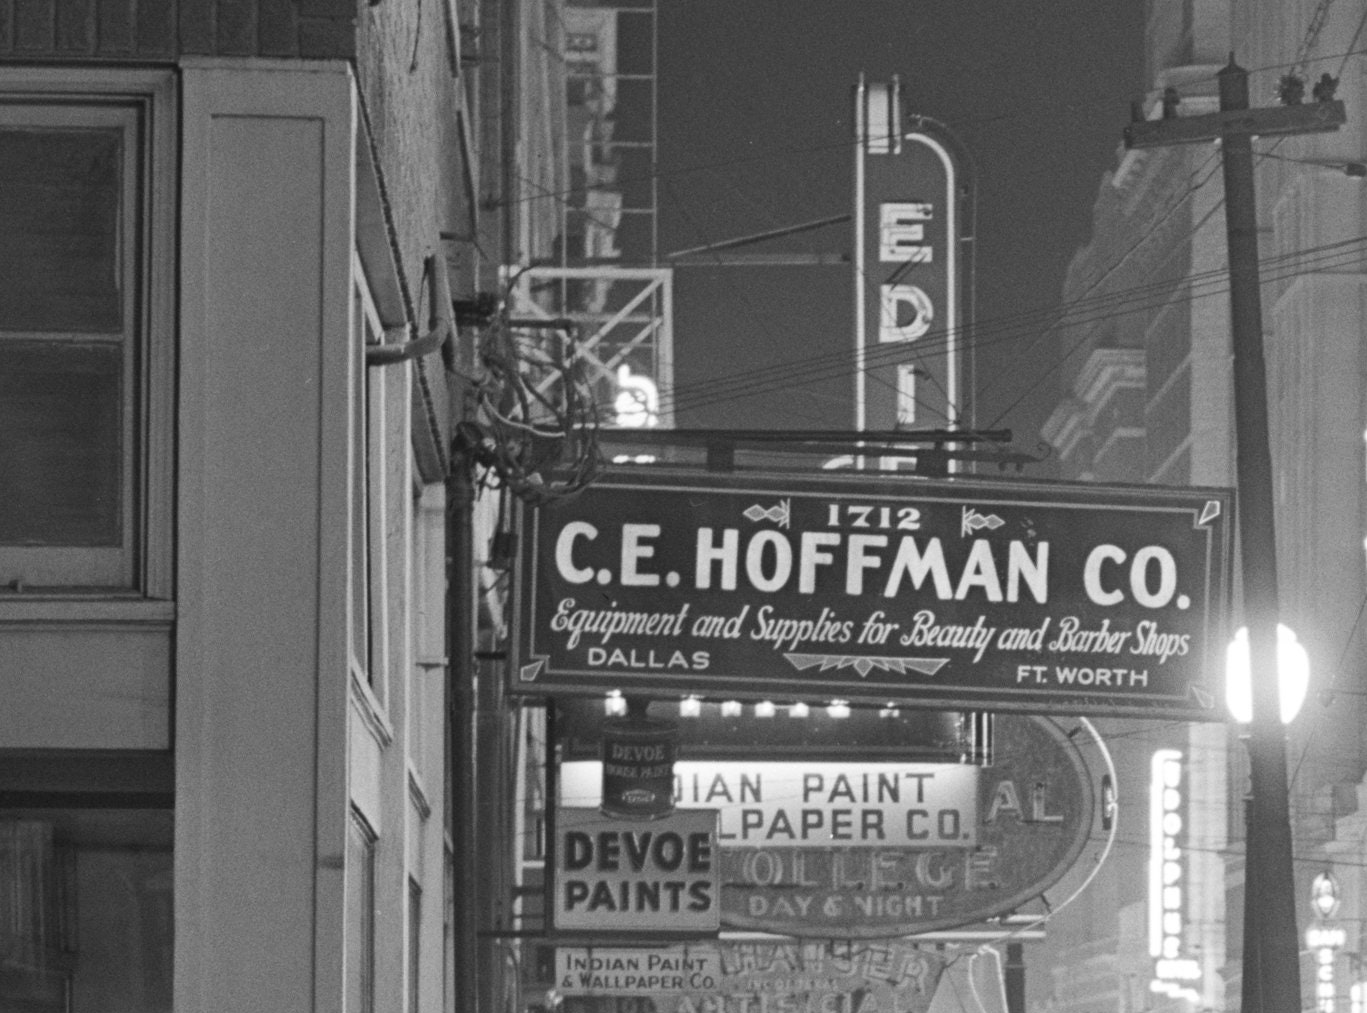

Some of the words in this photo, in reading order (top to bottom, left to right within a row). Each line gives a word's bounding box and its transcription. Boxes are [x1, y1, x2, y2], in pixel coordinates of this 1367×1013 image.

[878, 203, 934, 470] EDI
[828, 503, 921, 530] 1712
[555, 520, 681, 588] C.E.
[695, 527, 1049, 604] HOFFMAN
[1083, 544, 1191, 610] CO.
[550, 598, 690, 650] Equipment
[692, 604, 750, 639] and
[750, 604, 854, 651] Supplies
[856, 610, 899, 646] for
[900, 610, 996, 664] Beauty
[997, 617, 1051, 651] and
[1048, 616, 1131, 655] Barber
[1130, 620, 1191, 665] Shops
[587, 647, 711, 670] DALLAS
[1016, 665, 1048, 684] FT.
[1055, 666, 1149, 688] WORTH
[612, 743, 666, 762] DEVOE
[676, 773, 763, 803] IAN
[803, 772, 936, 804] PAINT
[905, 808, 971, 841] CO.
[563, 831, 712, 874] DEVOE
[724, 848, 998, 892] OLLEGE
[563, 880, 712, 913] PAINTS
[750, 896, 813, 917] DAY
[823, 896, 843, 917] &
[854, 896, 945, 917] NIGHT
[562, 974, 574, 989] &
